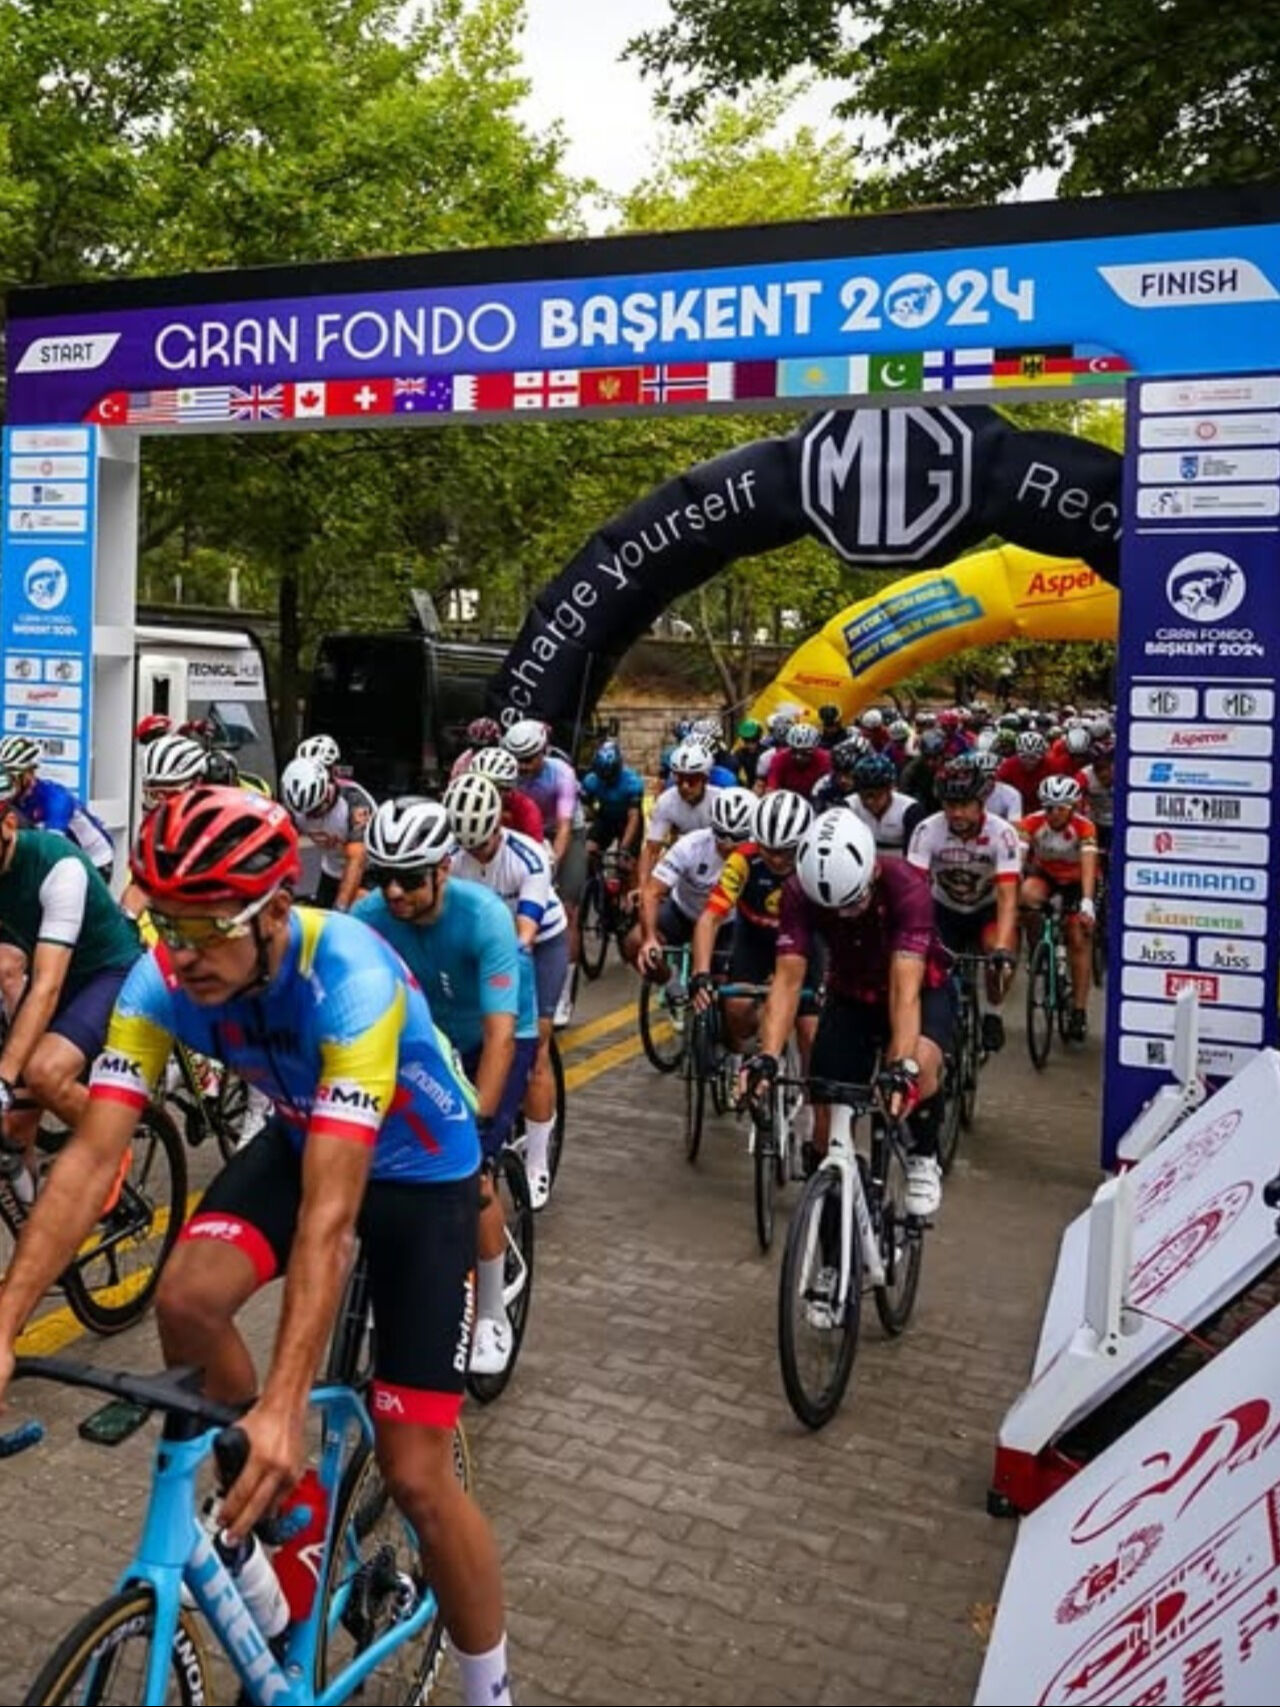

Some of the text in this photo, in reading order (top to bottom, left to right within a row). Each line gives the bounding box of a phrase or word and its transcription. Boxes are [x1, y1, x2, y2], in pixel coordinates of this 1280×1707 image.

[1141, 270, 1238, 297] FINISH
[155, 267, 1035, 370] GRAN FONDO BAŞKENT 2024
[39, 342, 94, 364] START
[819, 407, 955, 546] MG
[1017, 461, 1122, 541] Rec
[1026, 570, 1096, 598] Asper
[501, 471, 758, 727] echarge yourself
[1155, 628, 1254, 641] GRAN FONDO
[1218, 643, 1265, 657] 2024
[1136, 869, 1256, 892] SHIMANO
